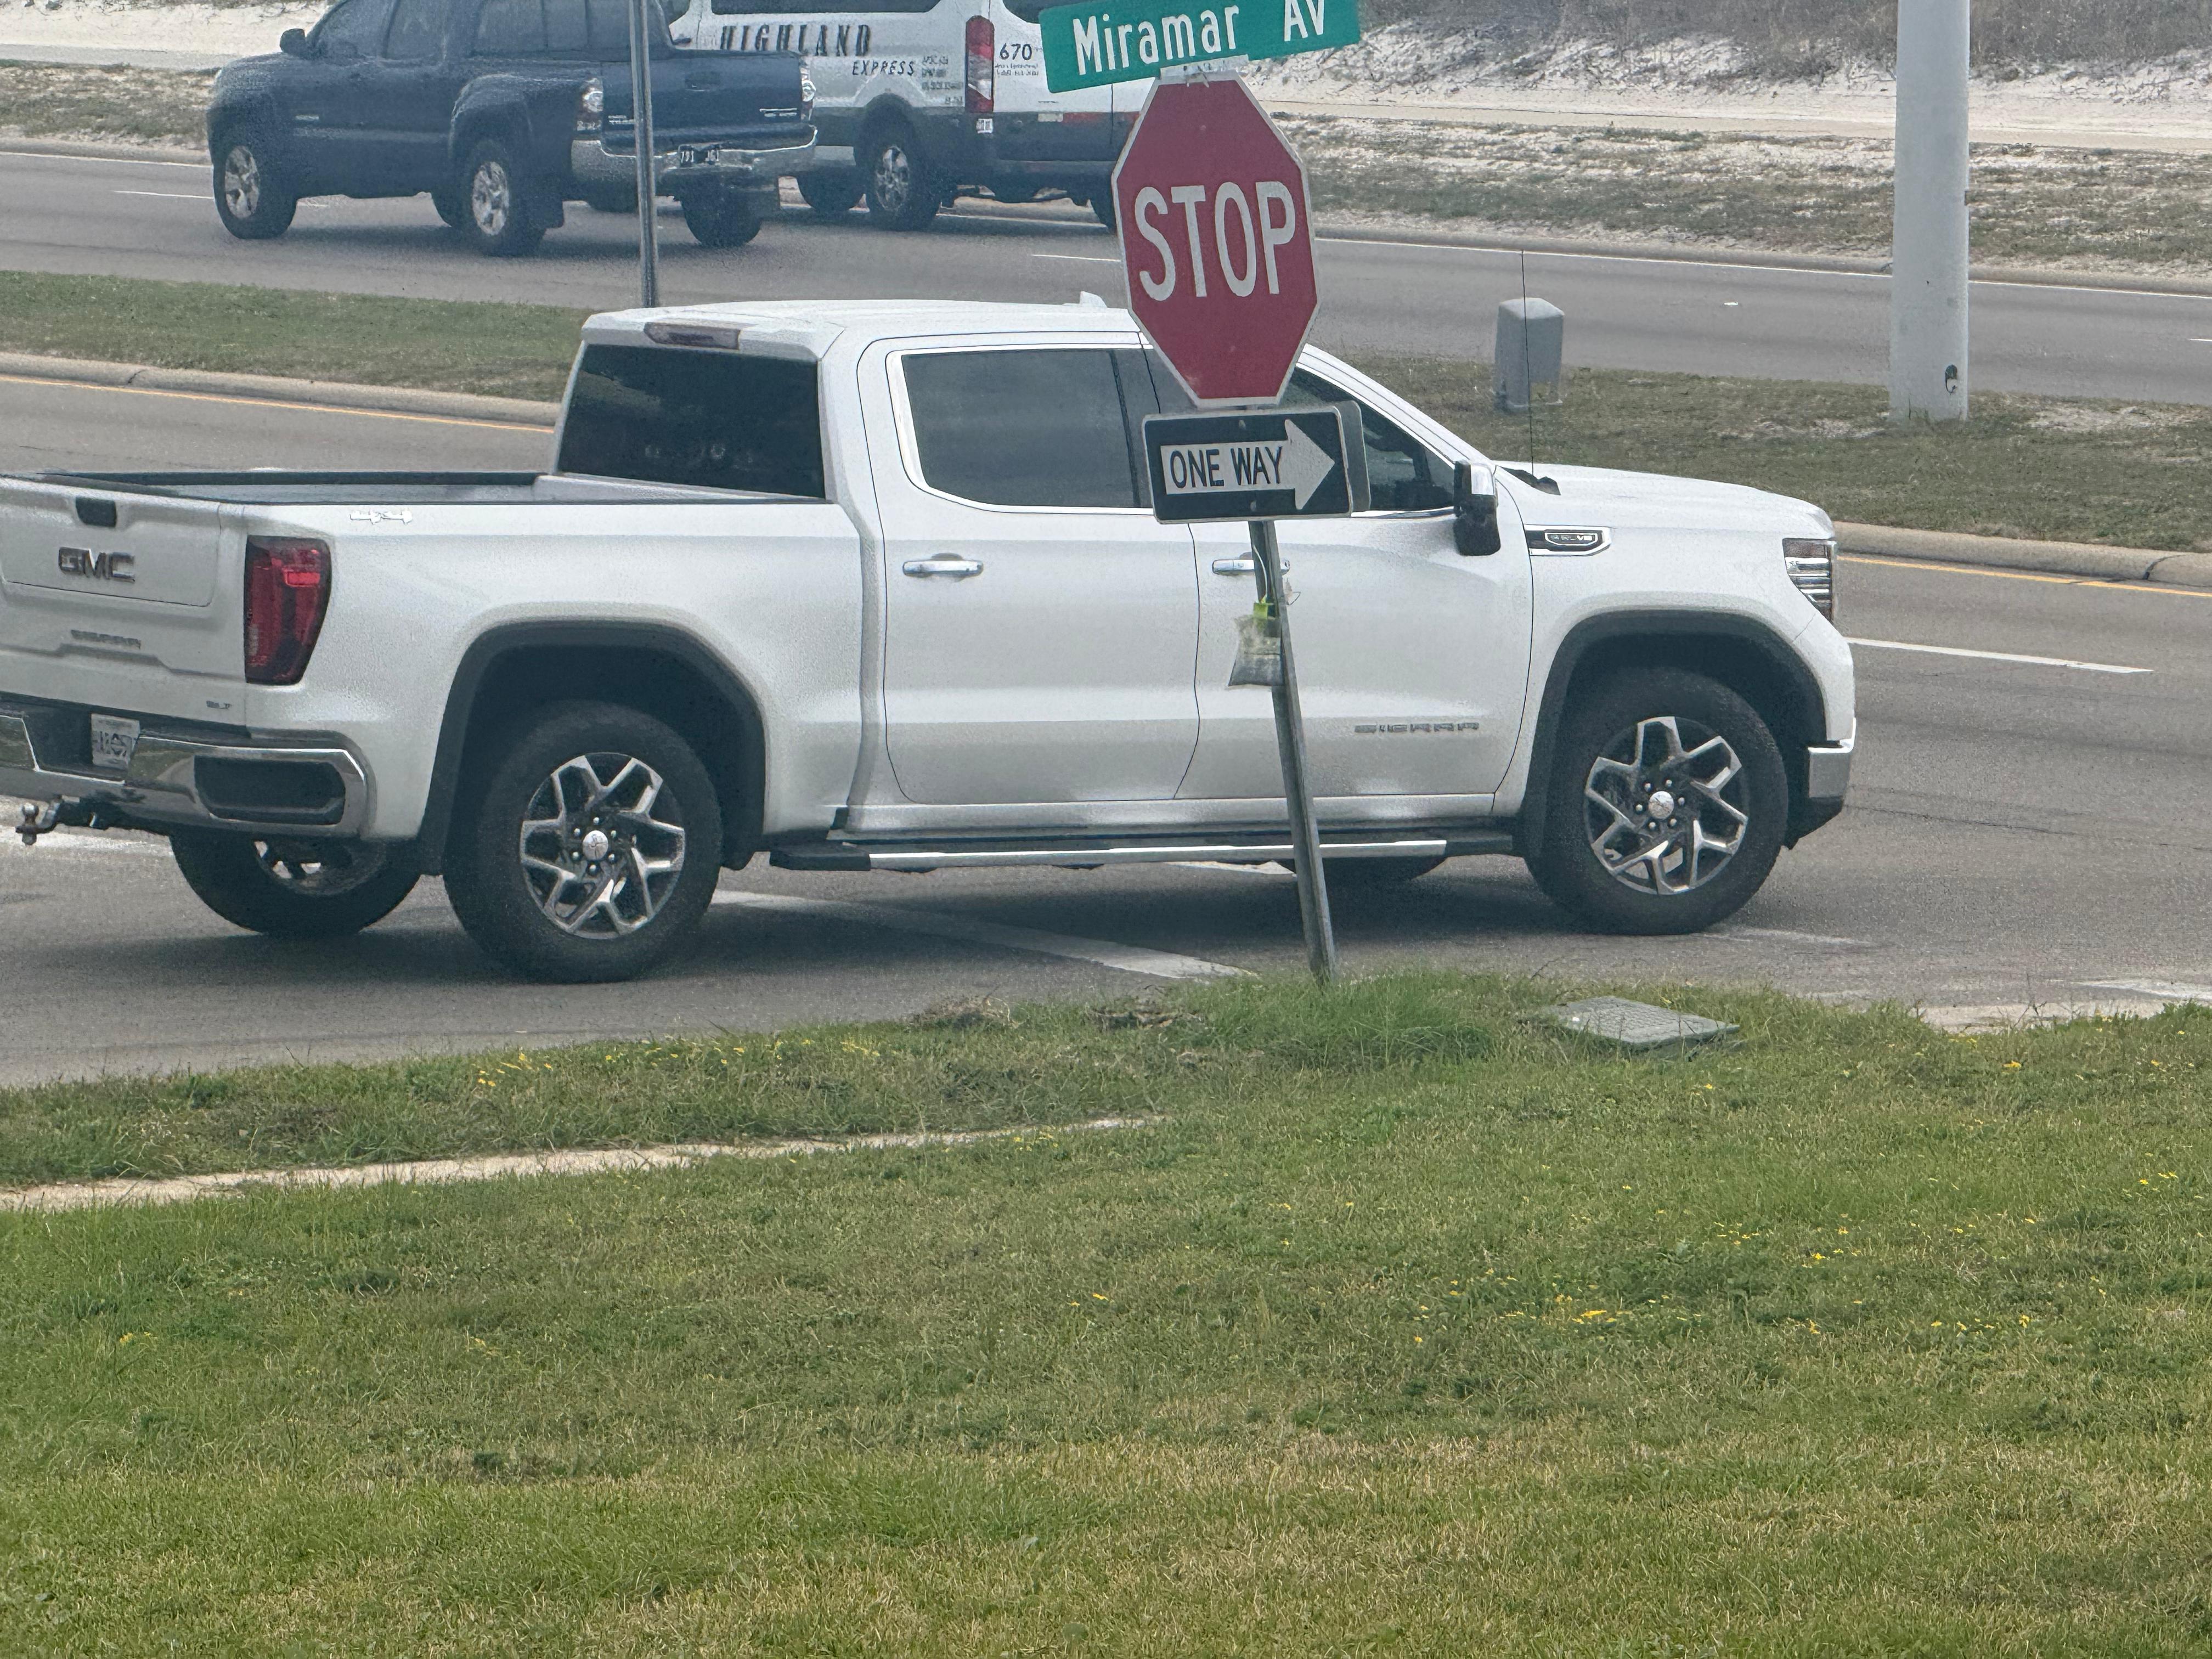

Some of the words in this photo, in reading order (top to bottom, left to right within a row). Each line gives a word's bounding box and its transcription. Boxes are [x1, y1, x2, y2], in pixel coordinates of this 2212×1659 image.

[720, 24, 871, 57] HIGHLAND
[999, 43, 1032, 61] 670
[1073, 5, 1240, 75] Miramar
[1284, 0, 1325, 42] AV
[851, 60, 915, 76] EXPRESS
[1134, 181, 1296, 302] STOP
[1170, 448, 1225, 489] ONE
[1230, 445, 1283, 486] WAY
[58, 546, 136, 582] GMC
